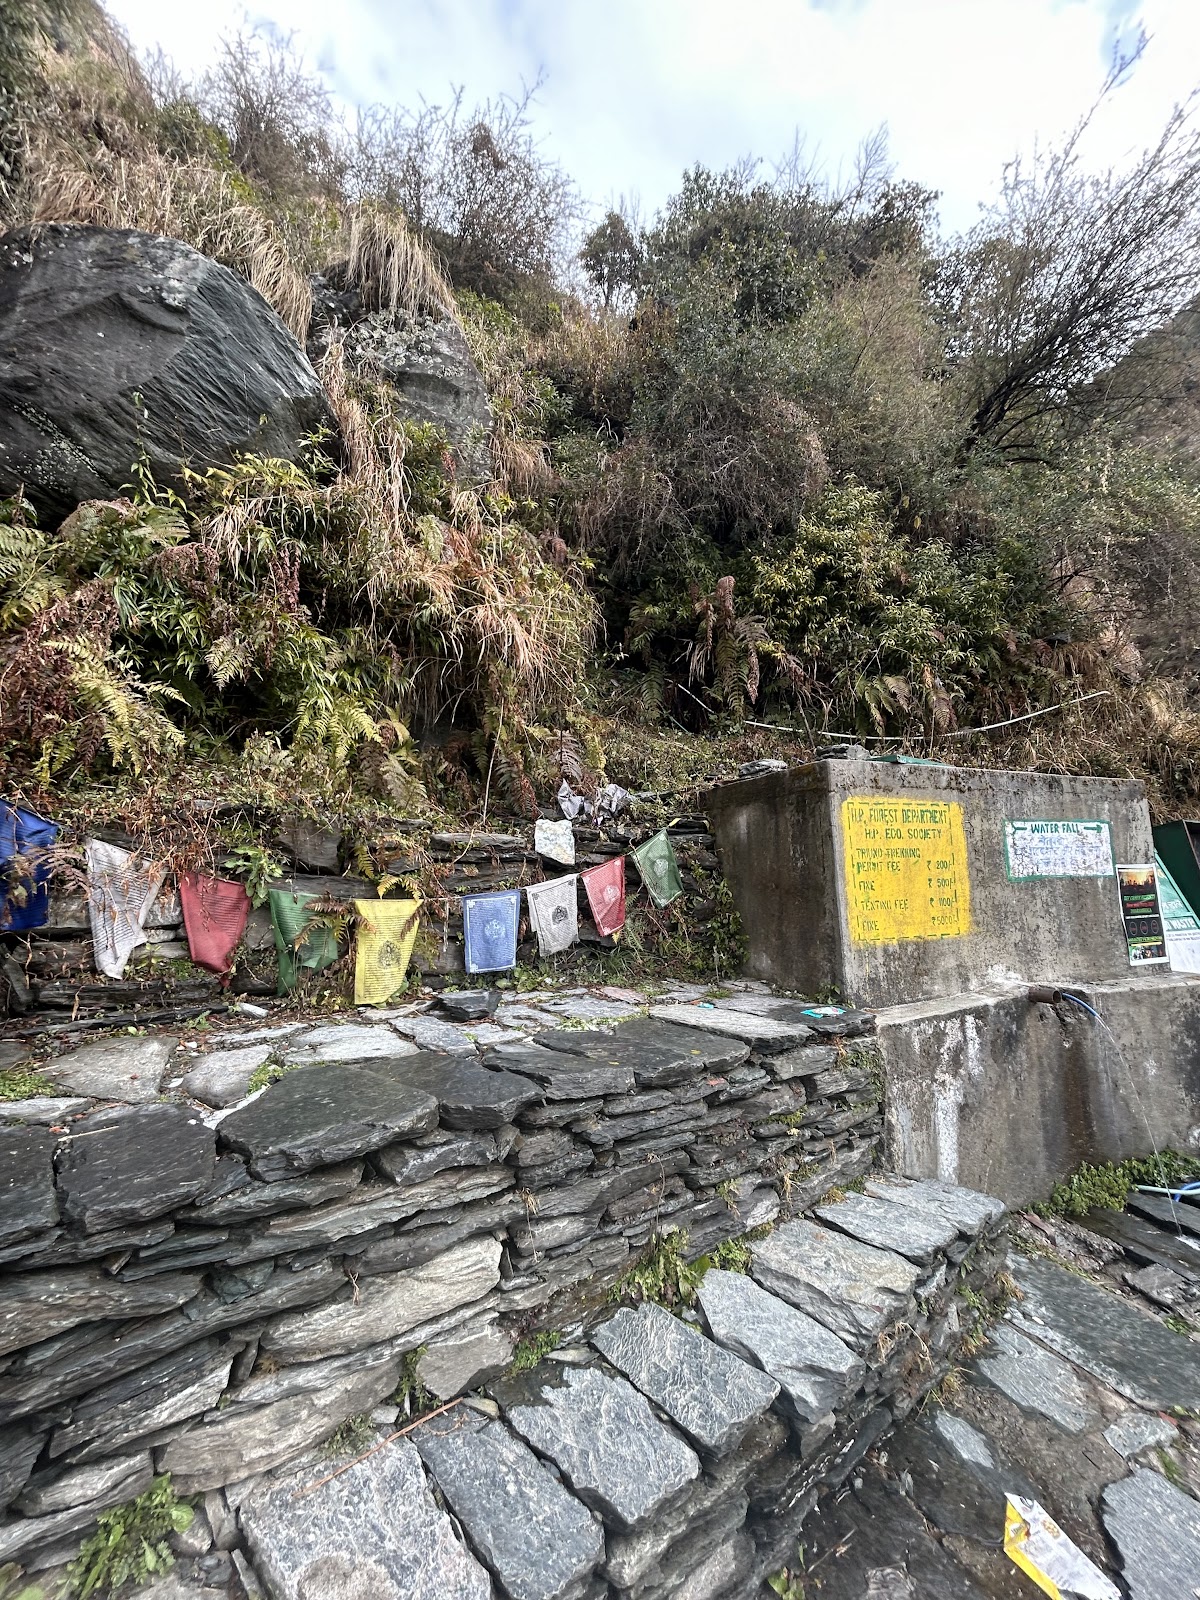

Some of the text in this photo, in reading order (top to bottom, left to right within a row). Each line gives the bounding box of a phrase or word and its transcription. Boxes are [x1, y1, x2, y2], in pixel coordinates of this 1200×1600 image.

[869, 808, 898, 823] FOREST
[901, 808, 948, 824] DEPARTMENT
[907, 828, 942, 840] SOCIETY
[1031, 823, 1080, 834] WATER FALL
[887, 860, 901, 871] FEE
[894, 899, 909, 911] FEE
